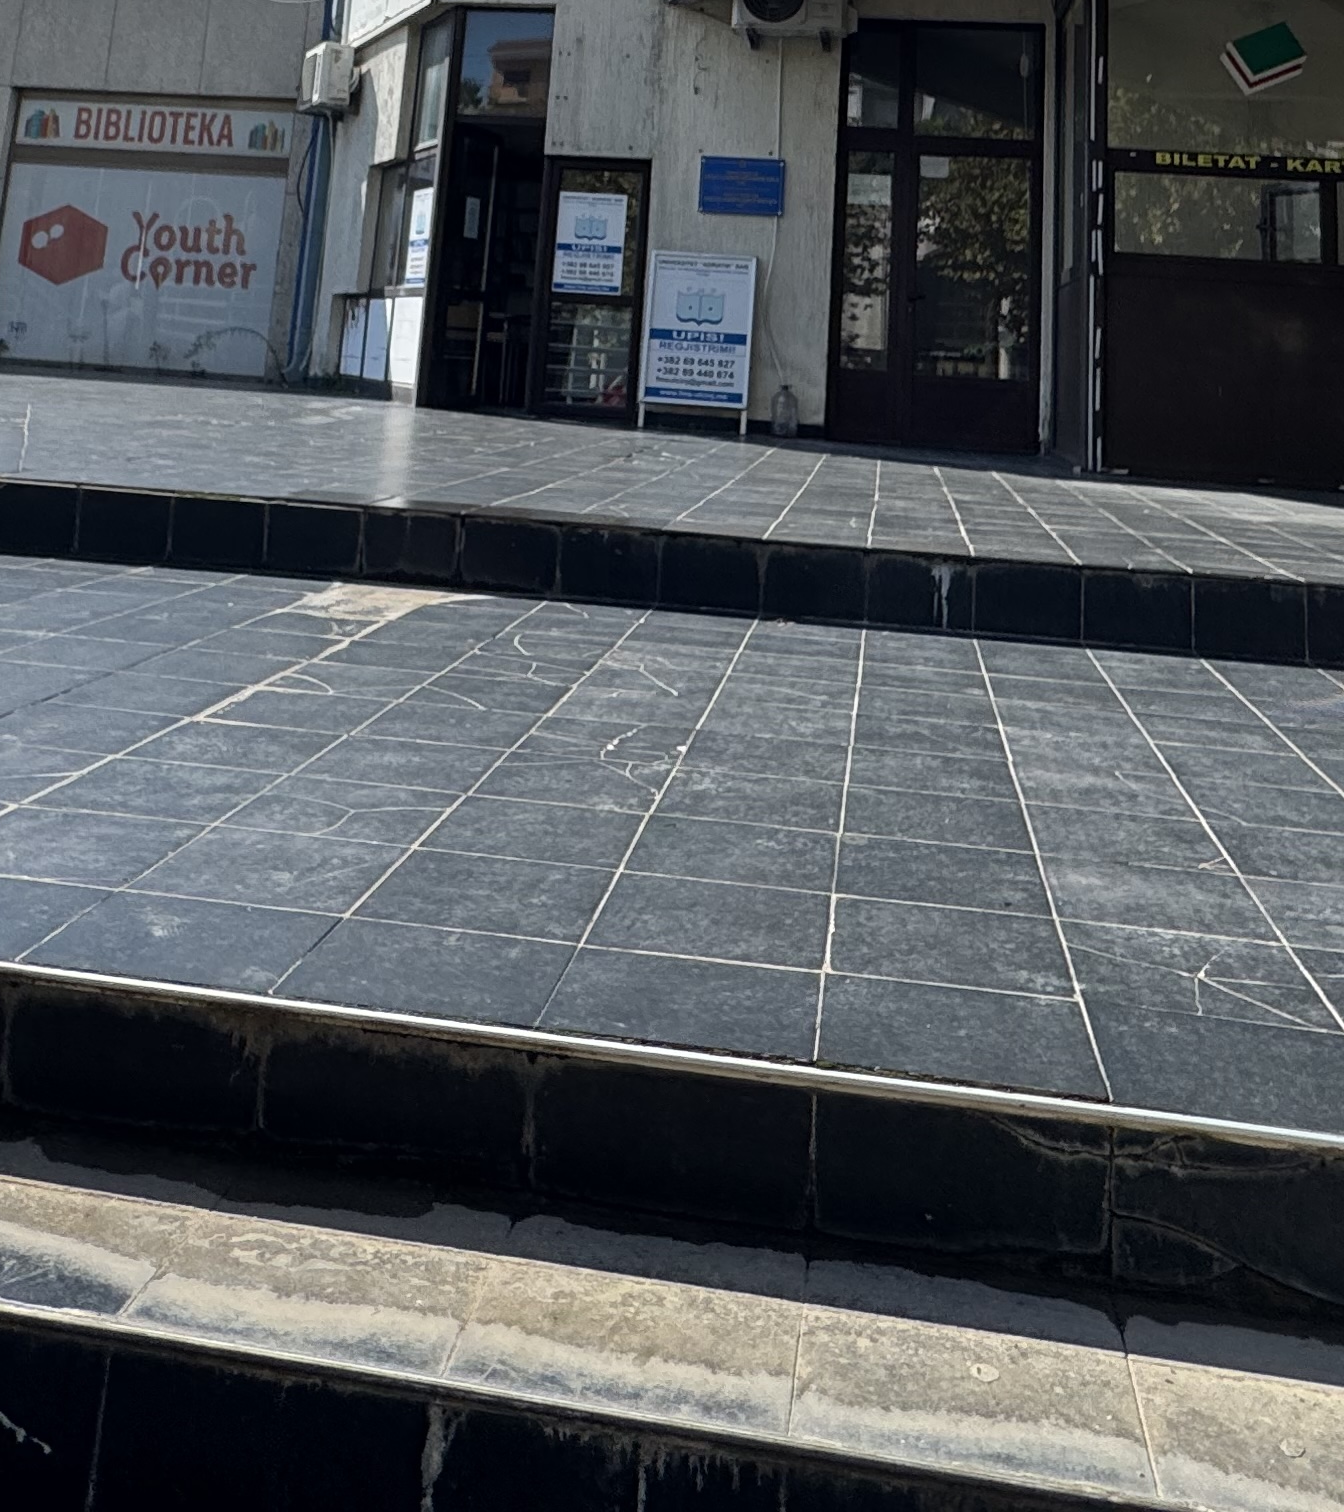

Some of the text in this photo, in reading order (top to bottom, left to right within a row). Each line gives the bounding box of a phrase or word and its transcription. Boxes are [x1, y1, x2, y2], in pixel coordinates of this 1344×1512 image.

[72, 106, 235, 148] BIBLIOTEKA
[1155, 150, 1262, 170] BILETAT
[132, 209, 246, 257] Youth
[120, 243, 258, 292] Corner
